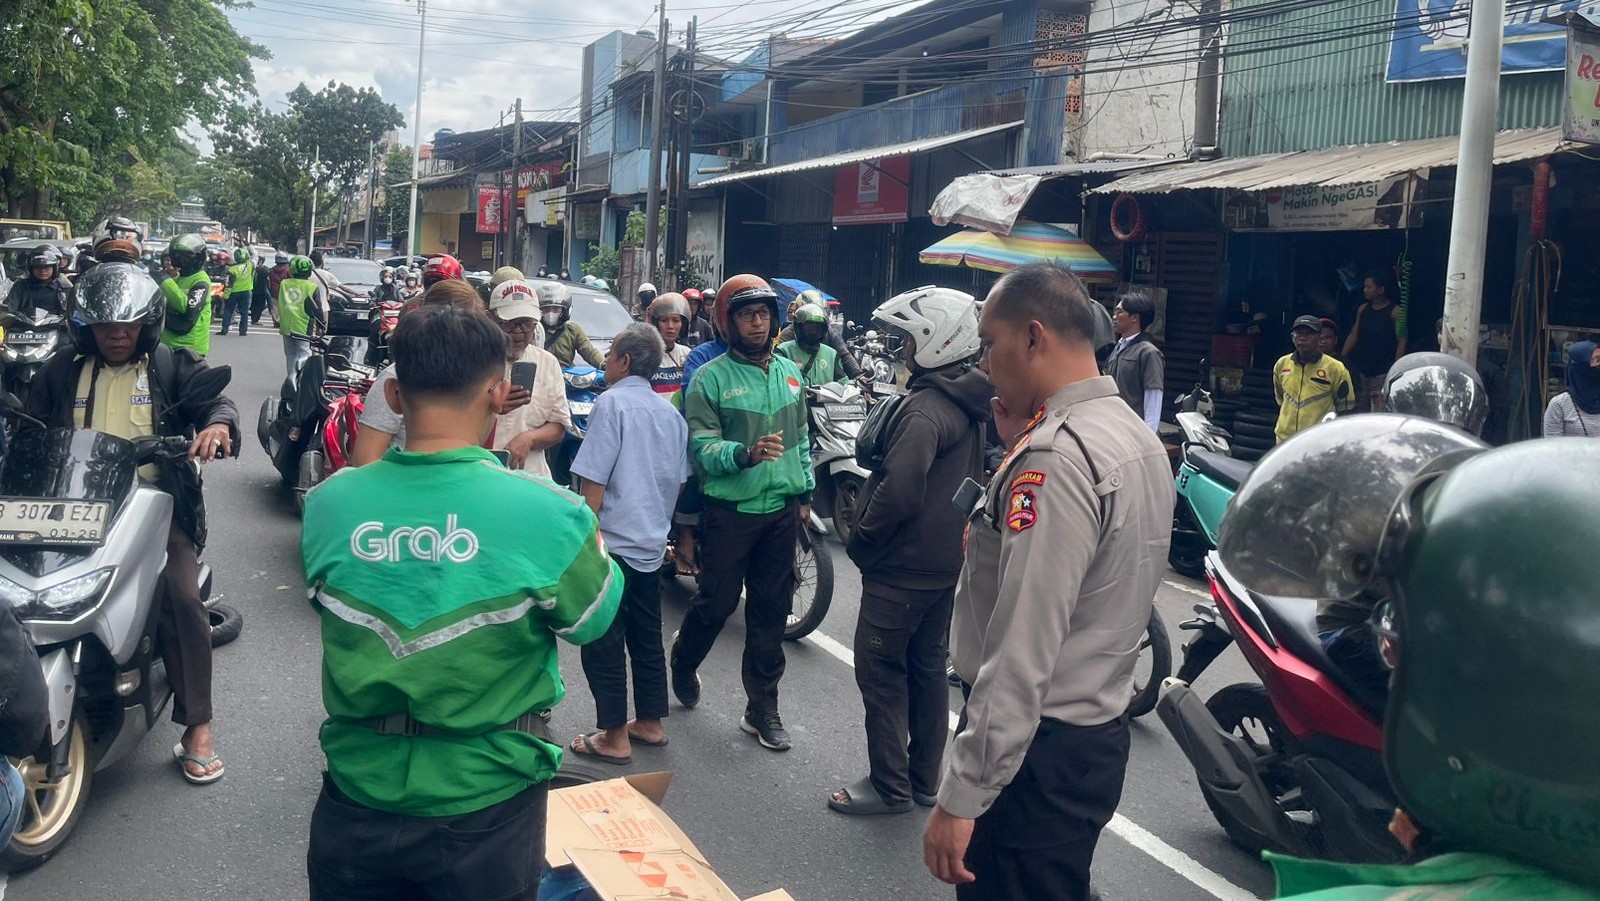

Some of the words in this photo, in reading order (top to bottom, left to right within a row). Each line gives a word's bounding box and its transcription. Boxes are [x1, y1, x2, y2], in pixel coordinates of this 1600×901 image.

[1283, 196, 1318, 210] Makin
[1321, 185, 1378, 206] NgeGAS!
[723, 385, 750, 399] Grab
[17, 503, 65, 521] 307
[70, 504, 103, 522] EZI
[49, 528, 98, 538] 03-28
[351, 513, 479, 563] Grab
